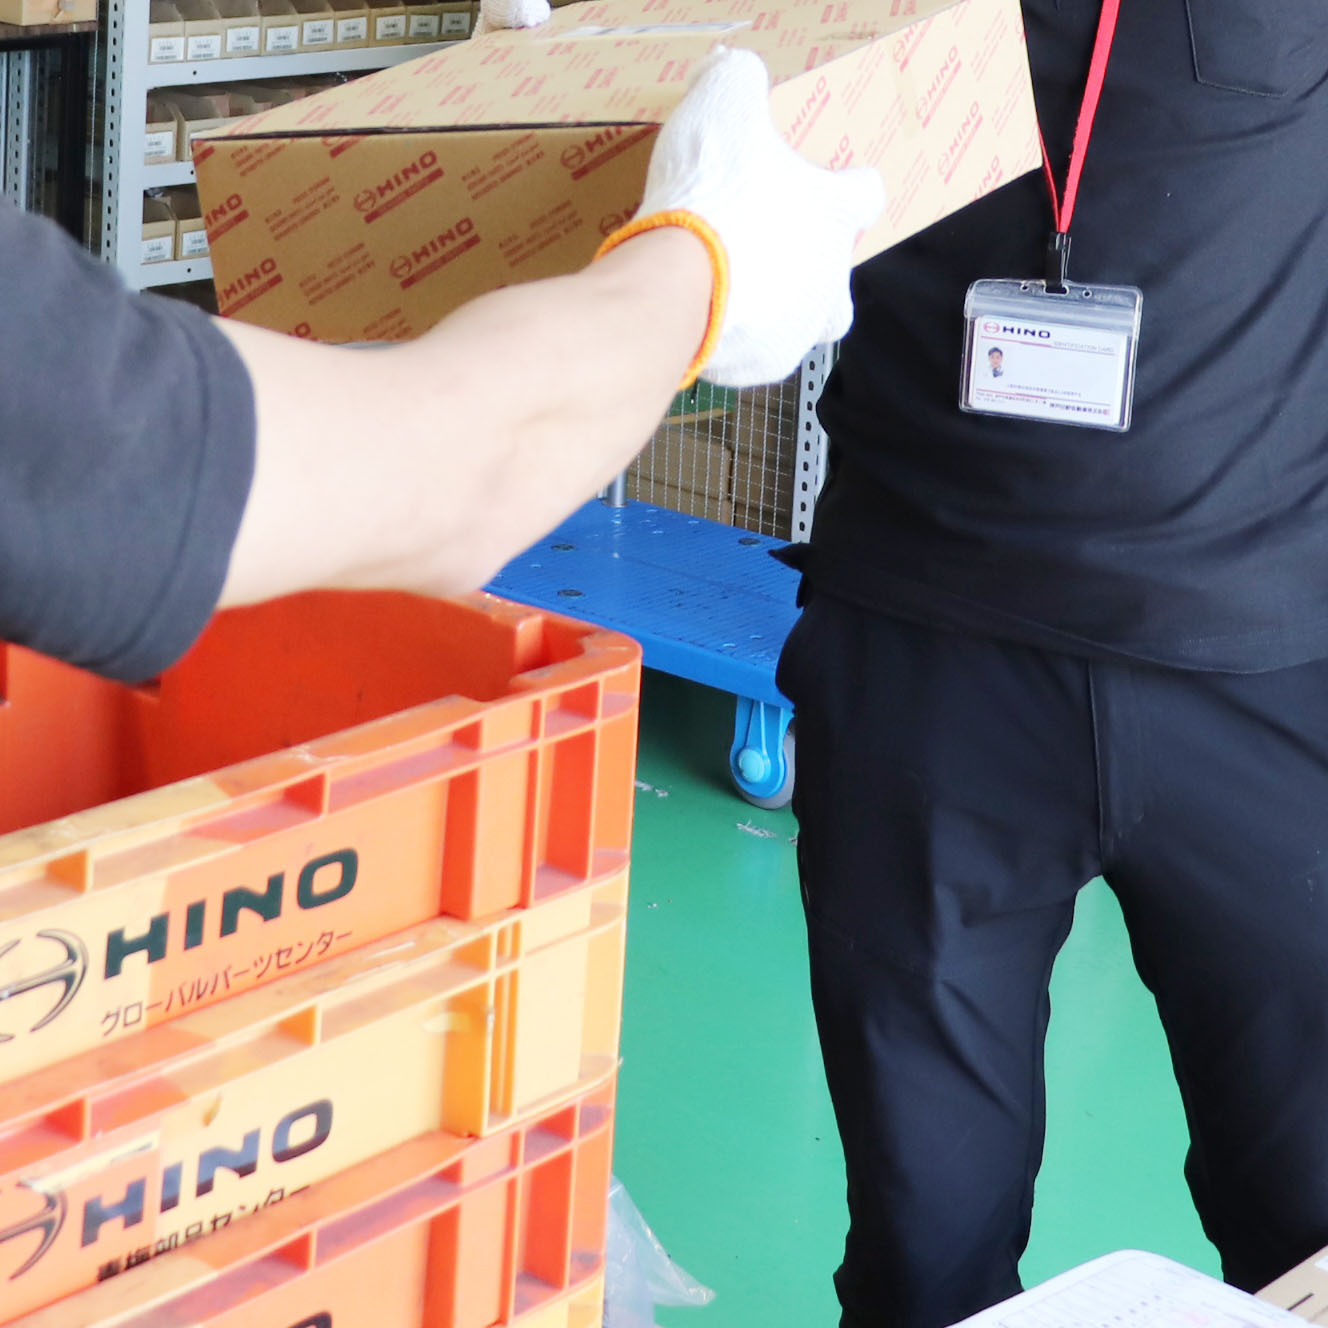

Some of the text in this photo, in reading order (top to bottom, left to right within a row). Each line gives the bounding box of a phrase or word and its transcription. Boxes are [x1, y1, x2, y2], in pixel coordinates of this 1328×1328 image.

[926, 46, 958, 101] HINO
[790, 75, 827, 138] HINO
[948, 101, 980, 156] HINO
[374, 150, 438, 200] HINO
[204, 193, 243, 227] INO
[410, 217, 475, 269] HINO
[1003, 325, 1051, 339] HINO
[103, 847, 359, 980] HINO
[99, 929, 354, 1037] グローバルパーツセンター
[80, 1097, 334, 1248] HINO
